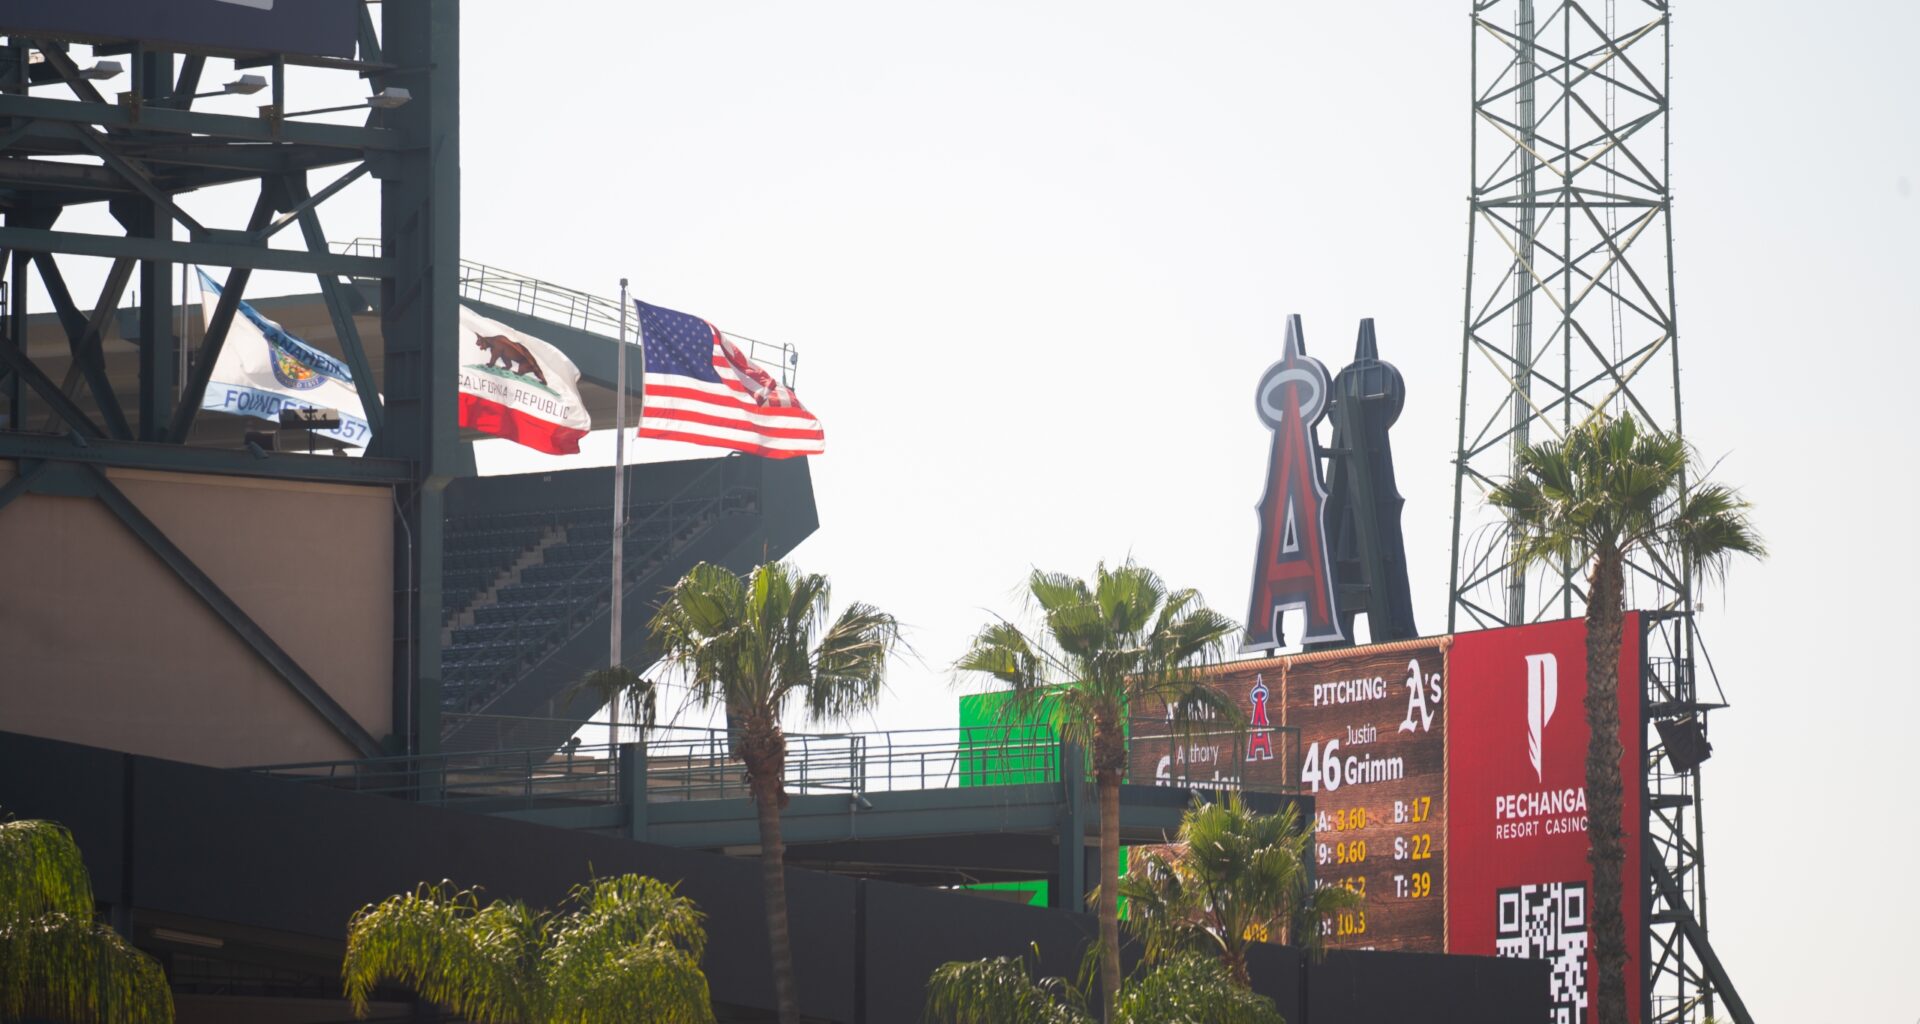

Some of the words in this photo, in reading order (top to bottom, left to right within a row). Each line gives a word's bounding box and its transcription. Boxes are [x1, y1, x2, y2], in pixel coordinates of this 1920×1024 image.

[224, 390, 309, 415] FOUND
[514, 389, 571, 419] REPUBLIC
[1314, 677, 1387, 706] PITCHING:
[1398, 659, 1442, 733] A's
[1346, 724, 1377, 745] Justin
[1176, 743, 1219, 766] Athony
[1302, 739, 1342, 793] 46
[1344, 753, 1404, 785] Grimm
[1394, 801, 1409, 824] B:
[1412, 797, 1431, 823] 17
[1496, 787, 1587, 820] PECHANGA
[1336, 807, 1367, 832] 3.60
[1496, 821, 1539, 839] RESORT
[1336, 840, 1367, 865] 9.60
[1394, 837, 1408, 861] S:
[1411, 833, 1432, 861] 22
[1394, 874, 1408, 898] T:
[1411, 871, 1431, 898] 39
[1337, 911, 1366, 936] 10.3
